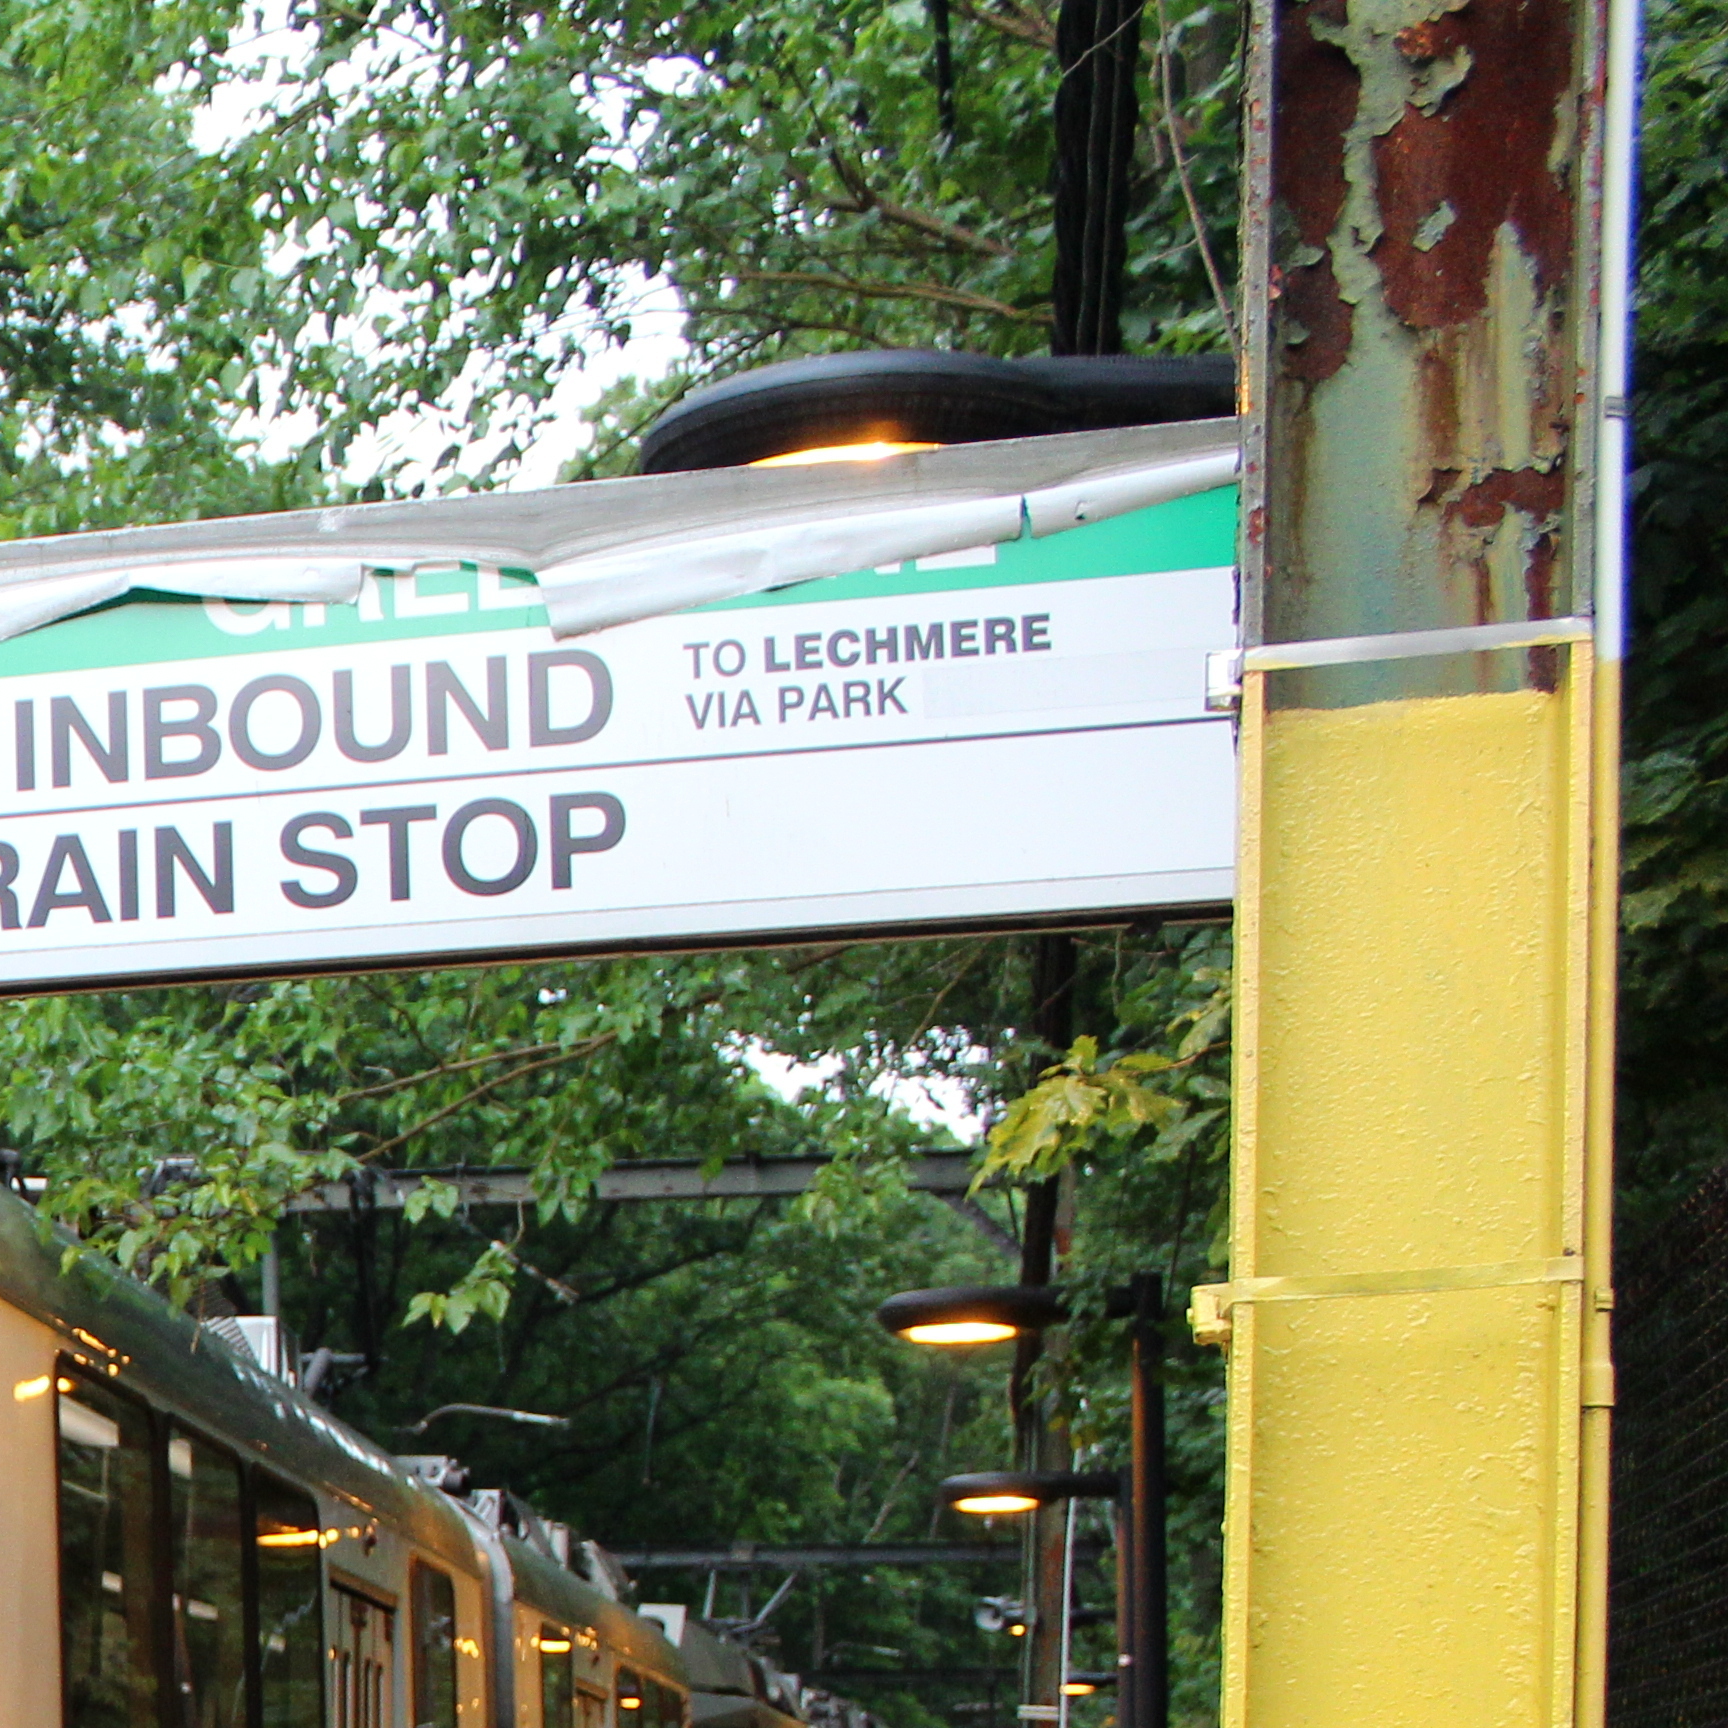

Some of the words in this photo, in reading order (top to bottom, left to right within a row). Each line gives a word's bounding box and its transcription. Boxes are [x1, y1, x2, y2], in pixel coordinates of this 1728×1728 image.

[683, 638, 746, 679] TO
[764, 613, 1052, 673] LECHMERE
[15, 649, 613, 791] INBOUND
[685, 689, 762, 730] VIA
[778, 677, 909, 724] PARK
[280, 791, 626, 909] STOP
